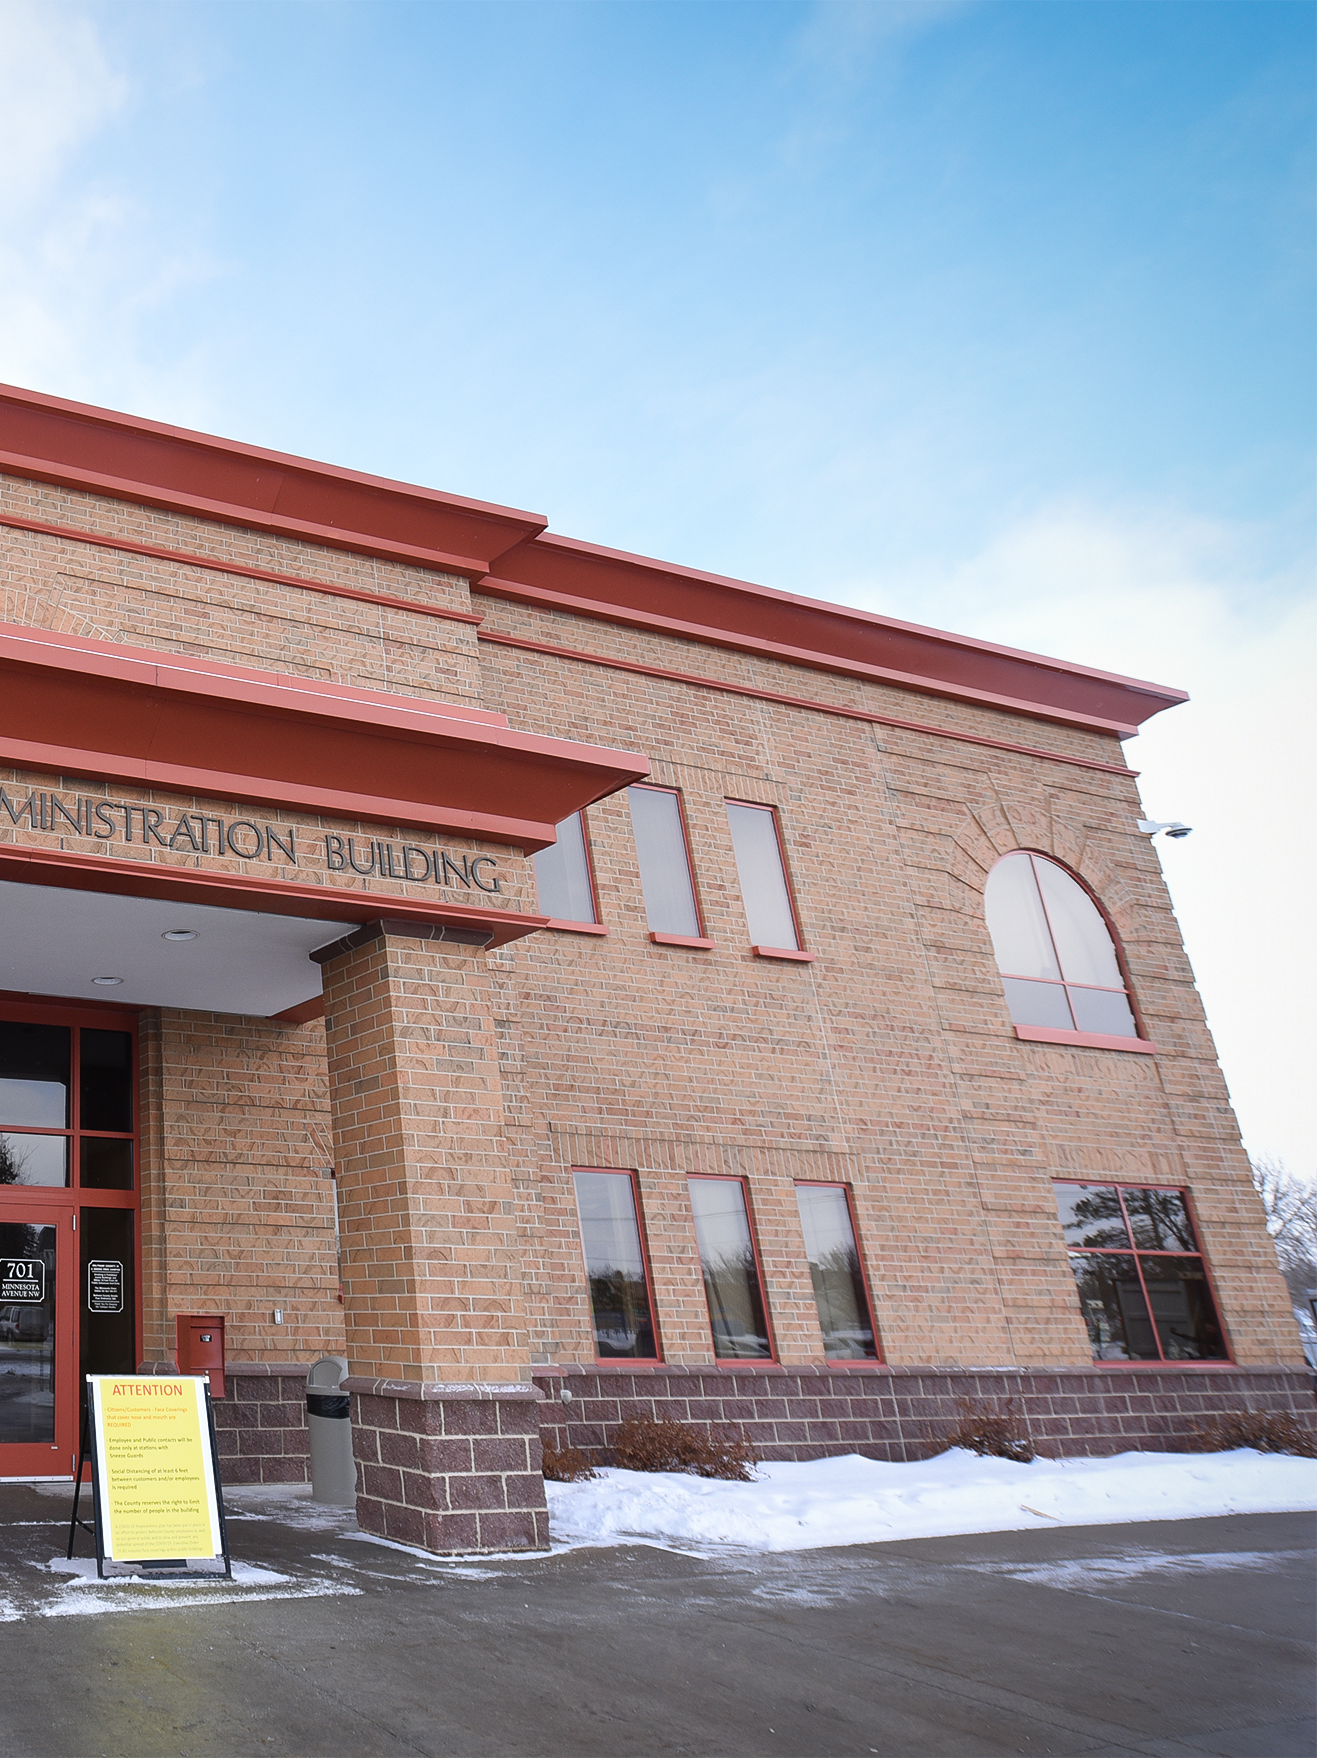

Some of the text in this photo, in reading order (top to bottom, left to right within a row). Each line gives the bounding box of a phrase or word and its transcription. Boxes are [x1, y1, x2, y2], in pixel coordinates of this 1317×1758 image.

[325, 834, 500, 893] BUILDING
[7, 1262, 34, 1278] 701
[112, 1384, 182, 1396] ATTENTION
